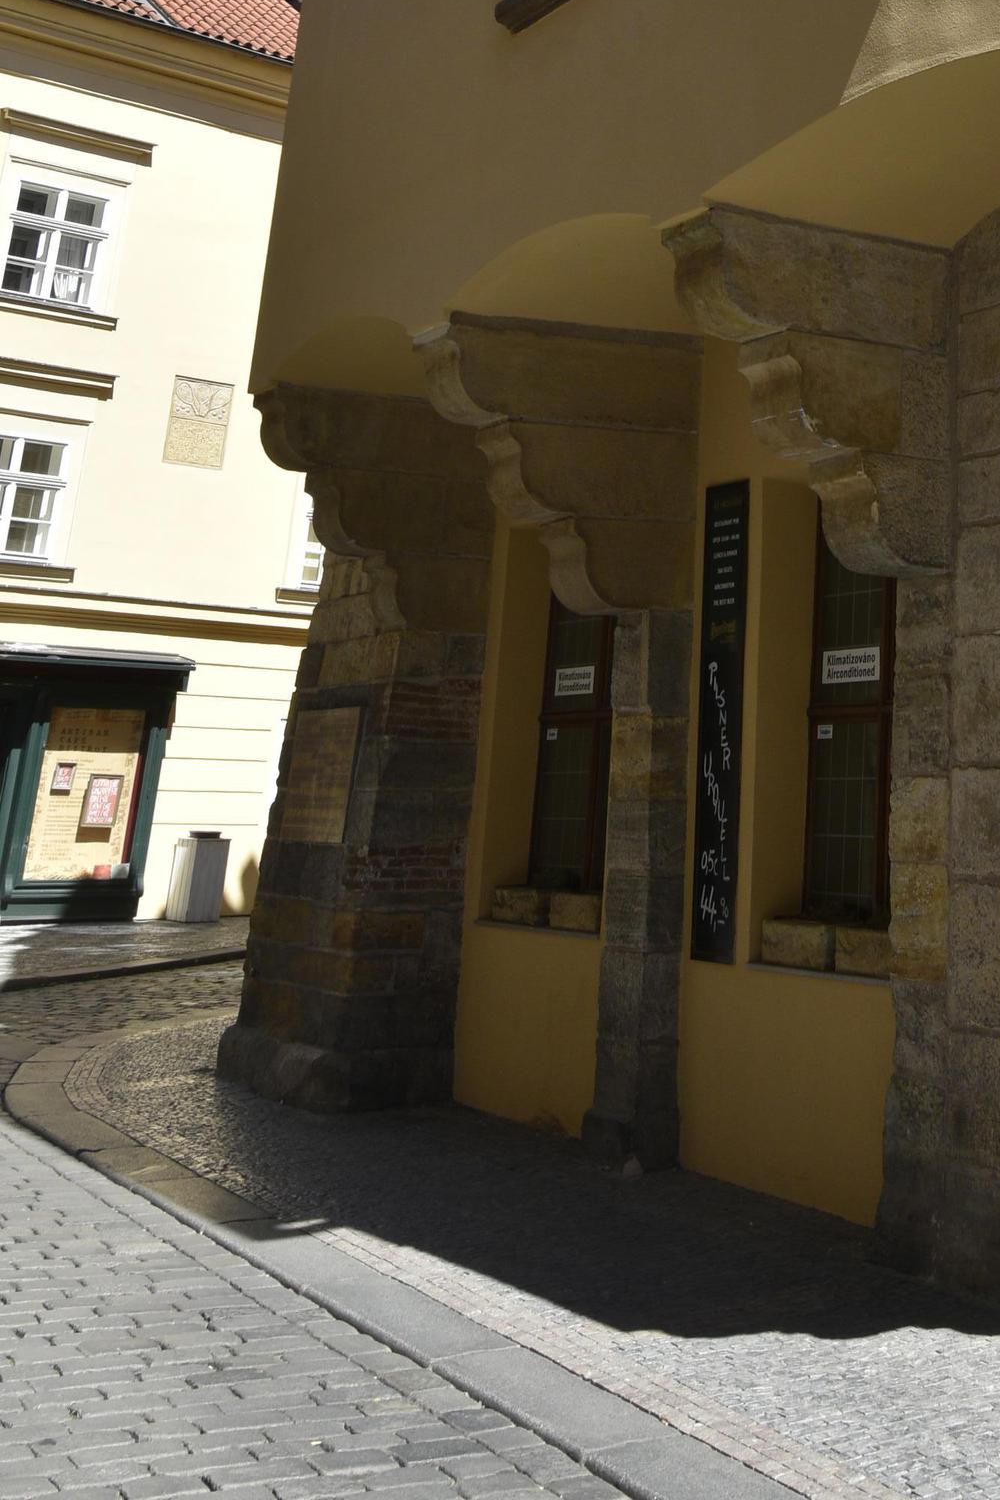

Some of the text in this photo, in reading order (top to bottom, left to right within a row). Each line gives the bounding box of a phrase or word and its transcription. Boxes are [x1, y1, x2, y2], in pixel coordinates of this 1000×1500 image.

[826, 652, 876, 666] Klimatizováno
[826, 666, 876, 680] Airconditioned
[708, 660, 731, 772] PILSNER
[703, 750, 731, 882] URQUELL
